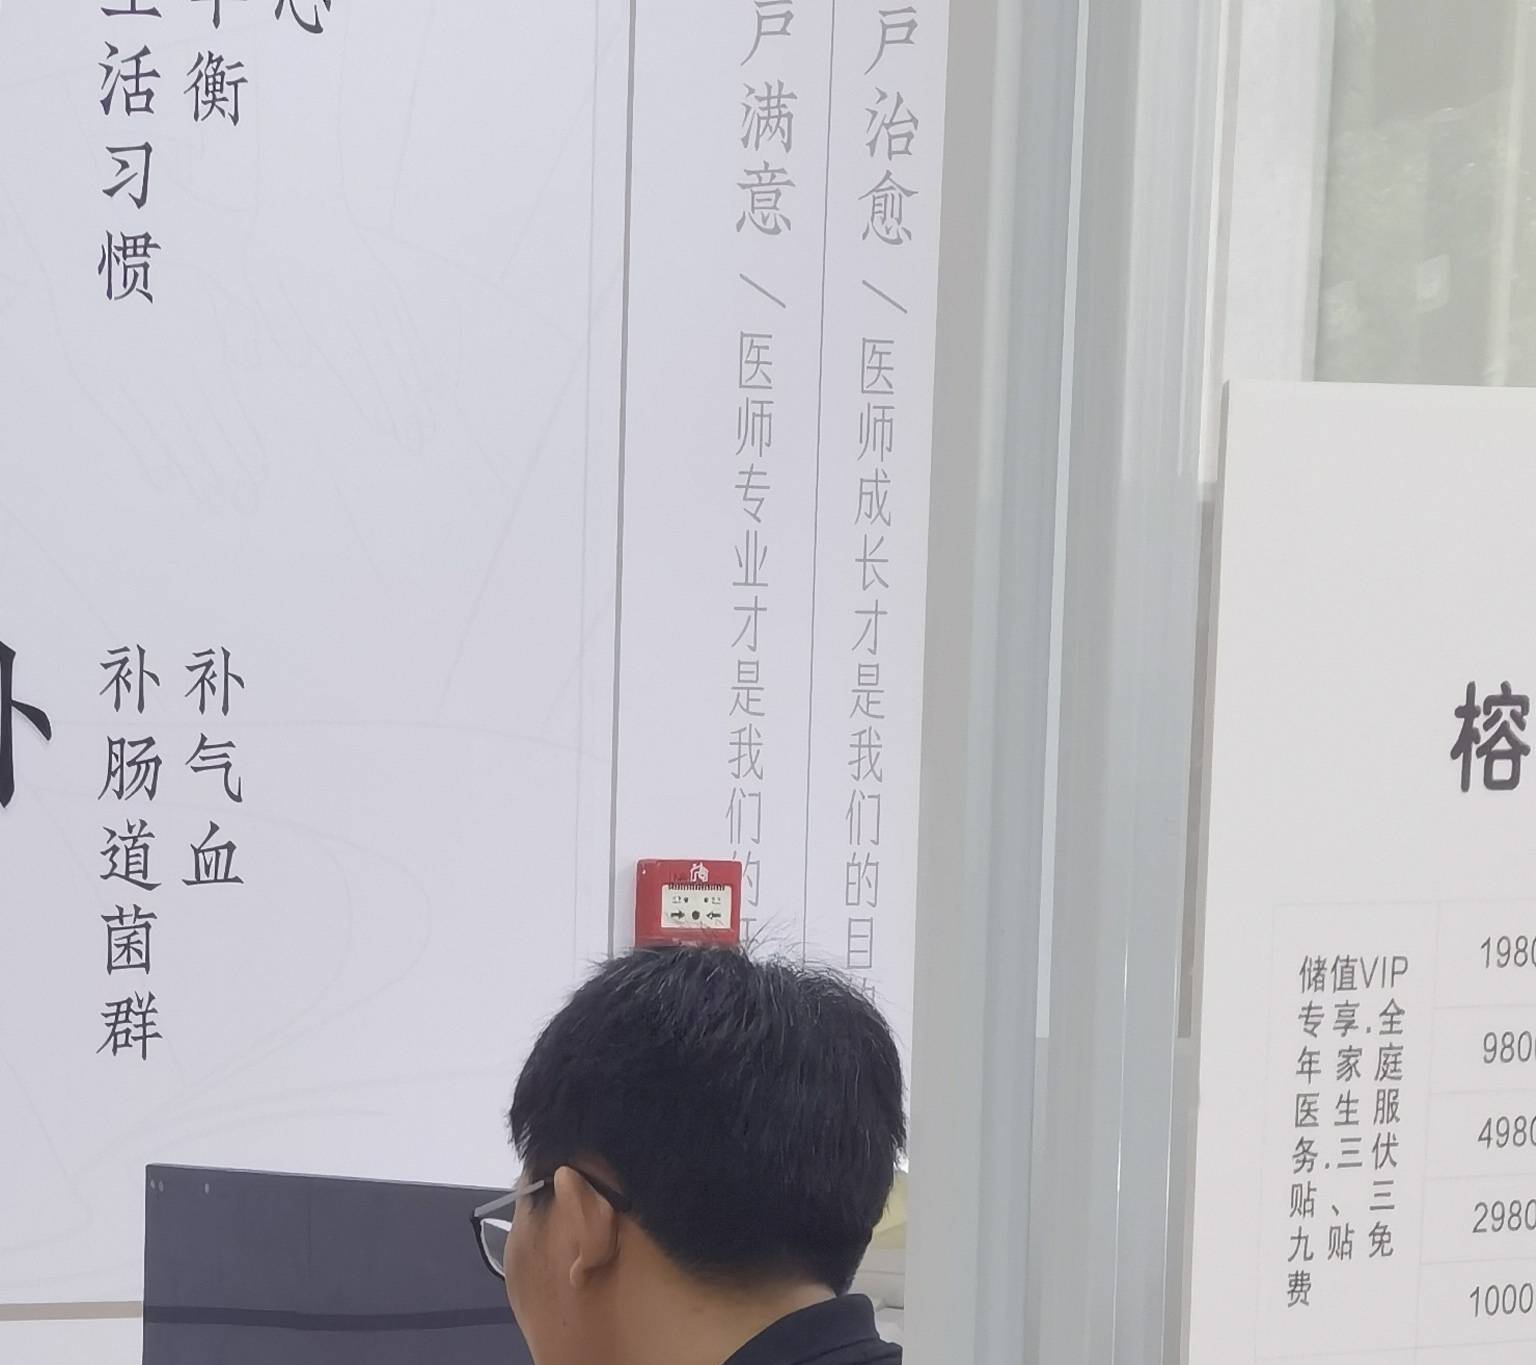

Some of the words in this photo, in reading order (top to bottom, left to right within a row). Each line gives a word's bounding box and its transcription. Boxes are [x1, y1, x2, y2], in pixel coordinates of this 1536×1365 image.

[1449, 680, 1532, 794] 榕
[181, 645, 245, 887] 补气血
[95, 643, 164, 1062] 补肠道菌群
[1298, 954, 1409, 994] 储值VIP
[1295, 1041, 1404, 1085] 年家庭
[1482, 1030, 1536, 1065] 980
[1294, 1087, 1401, 1129] 医生服
[1287, 1220, 1394, 1263] 九贴免
[1286, 1269, 1312, 1309] 费
